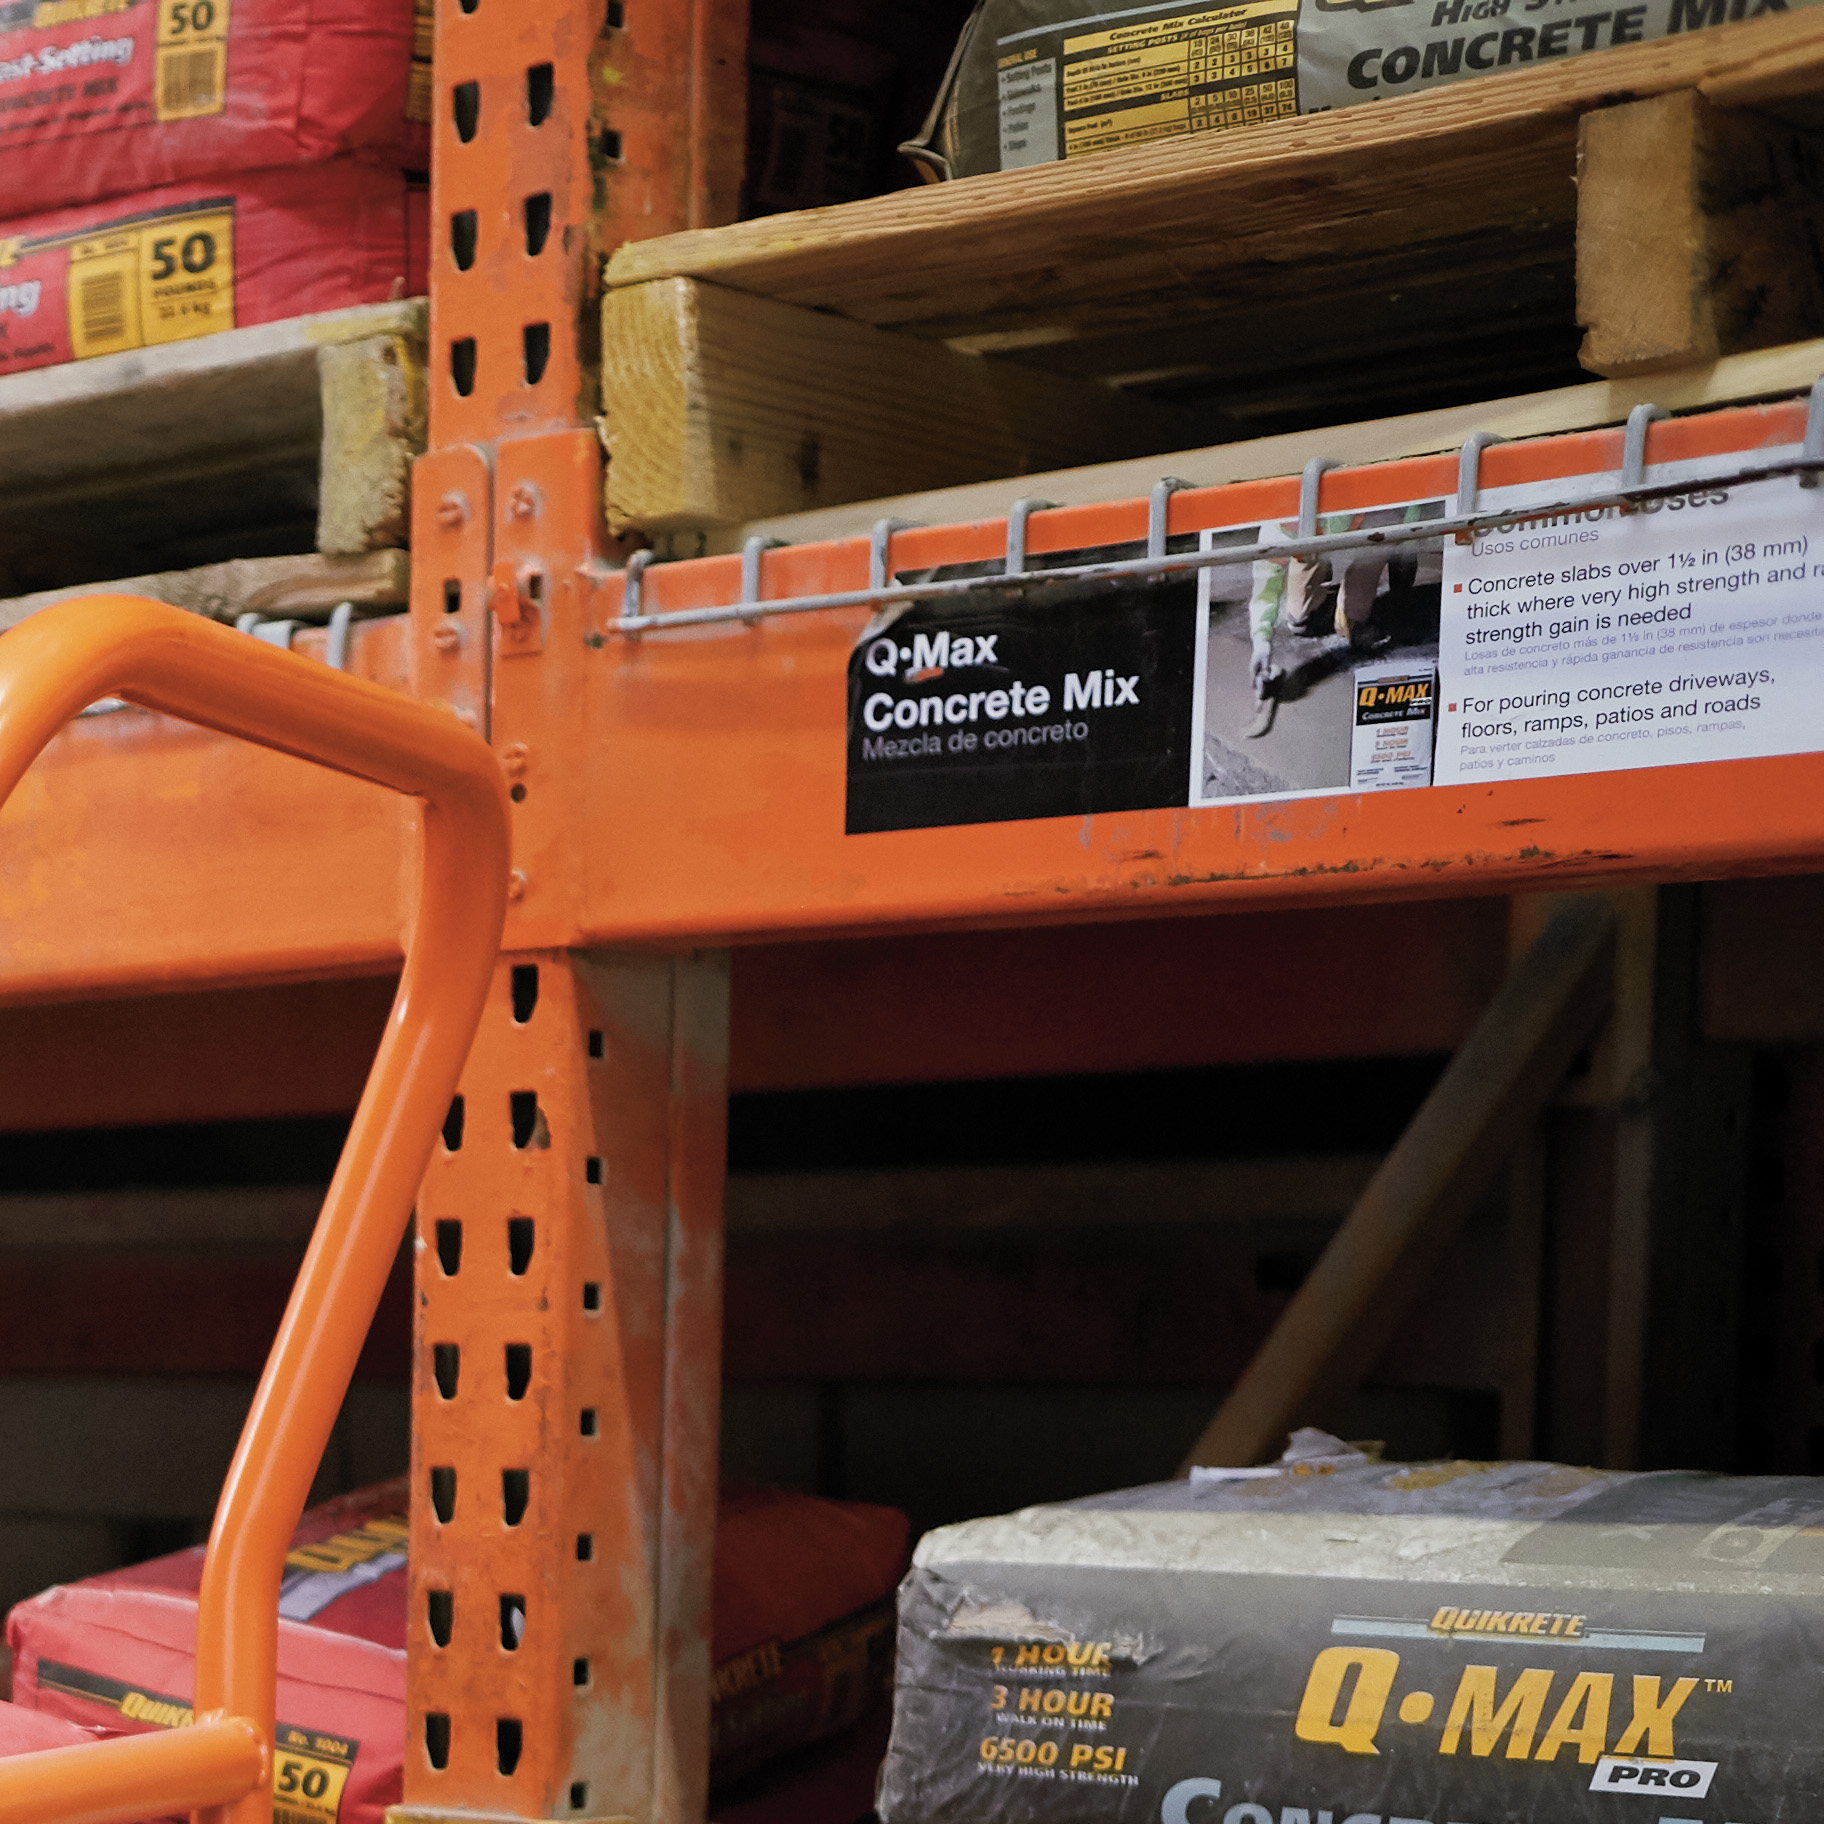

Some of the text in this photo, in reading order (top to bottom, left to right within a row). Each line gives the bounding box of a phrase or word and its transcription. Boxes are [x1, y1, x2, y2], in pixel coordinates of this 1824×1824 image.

[1110, 9, 1247, 41] Concrete Mix Calculator
[1348, 7, 1647, 90] CONCRETE
[151, 231, 217, 280] 50
[1472, 530, 1599, 557] Usos comunes
[1468, 572, 1554, 594] Concrete
[1561, 564, 1611, 583] slabs
[1618, 557, 1660, 575] over
[1702, 549, 1718, 565] in
[1725, 543, 1755, 566] (38
[1763, 536, 1808, 557] mm)
[1468, 562, 1805, 619] thick where very high strength and
[1466, 622, 1542, 644] strength
[1550, 616, 1589, 639] gain
[1596, 614, 1611, 629] is
[1618, 603, 1692, 627] needed
[1465, 636, 1616, 661] Losas de concreto más de
[864, 669, 1140, 732] Concrete Mix
[1463, 669, 1775, 714] For pouring concrete driveways,
[1462, 694, 1761, 738] floors, ramps, patios and roads
[862, 720, 1089, 761] Mezcla de concreto
[1460, 745, 1486, 755] Para
[1525, 737, 1575, 750] calzadas
[1460, 759, 1494, 772] patios
[1507, 753, 1555, 766] caminos
[1430, 1606, 1587, 1638] QUIKRETE
[979, 1736, 1126, 1772] 6500 PSI
[278, 1762, 329, 1799] 50
[1607, 1765, 1701, 1788] PRO
